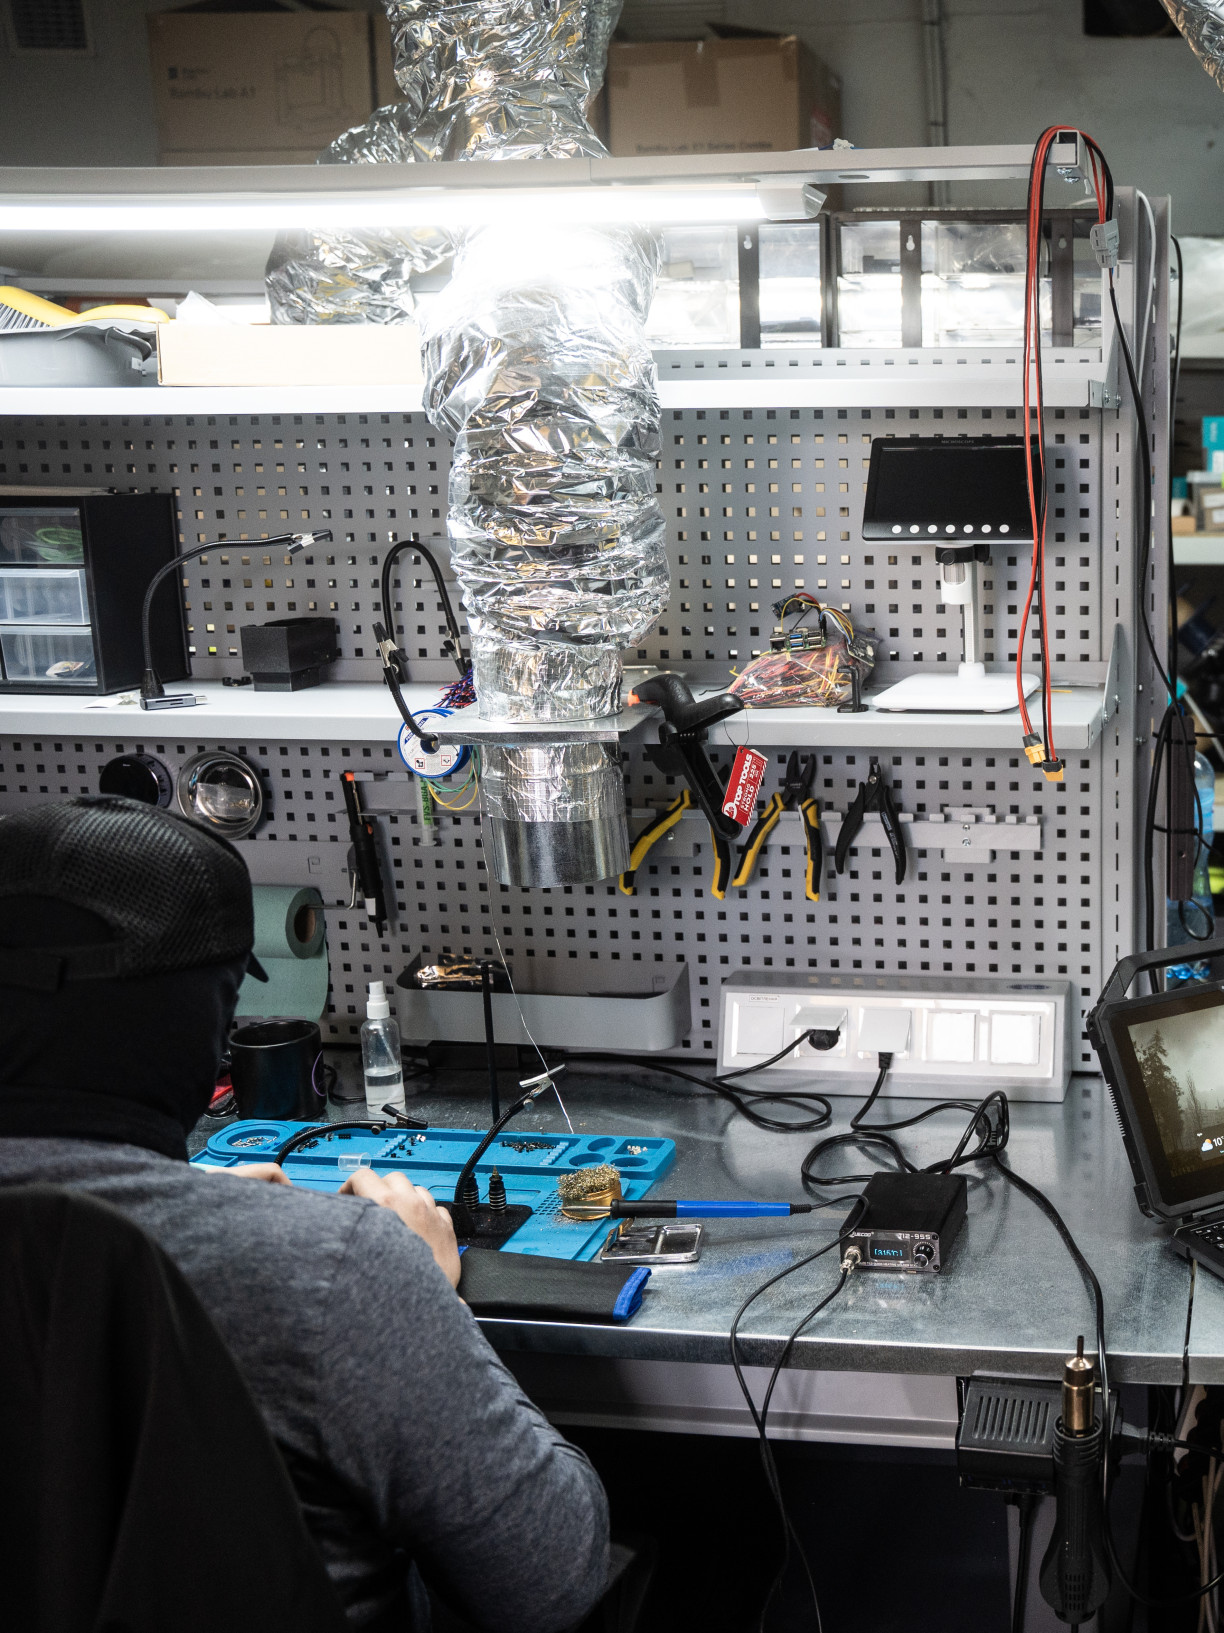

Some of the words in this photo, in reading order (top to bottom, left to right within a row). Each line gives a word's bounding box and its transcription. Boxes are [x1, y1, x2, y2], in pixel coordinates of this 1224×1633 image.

[734, 785, 743, 805] TOP
[739, 754, 753, 785] TOOLS
[743, 785, 755, 811] HOLD
